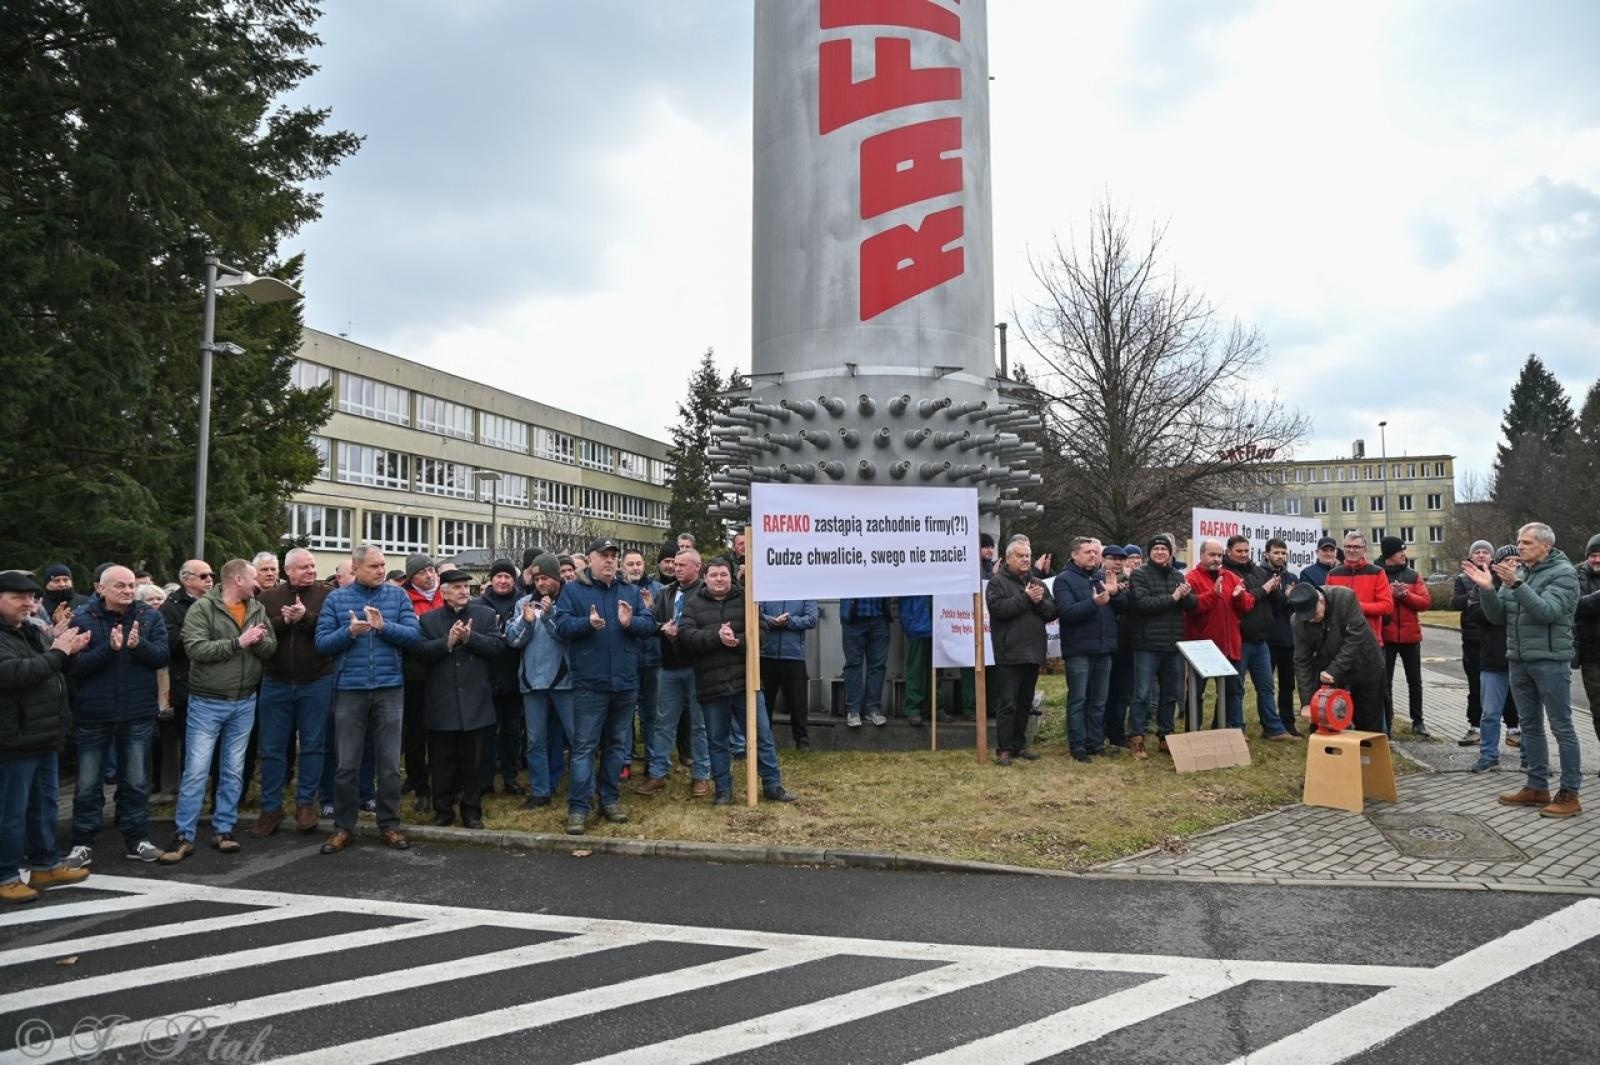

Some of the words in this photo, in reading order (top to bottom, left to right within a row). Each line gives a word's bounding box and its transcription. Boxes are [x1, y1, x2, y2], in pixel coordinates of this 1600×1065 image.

[763, 514, 811, 533] RAFAKO
[814, 515, 863, 537] zastąpią
[866, 515, 921, 533] zachodnie
[924, 515, 968, 536] firmy(?!)
[1200, 520, 1238, 538] RAFAKO
[1242, 524, 1252, 539] to
[1255, 525, 1270, 540] nie
[1273, 526, 1317, 546] ideologia!
[766, 547, 803, 566] Cudze
[807, 547, 867, 567] chwalicie,
[870, 550, 906, 567] swego
[909, 546, 926, 563] nie
[929, 545, 967, 563] znacie!
